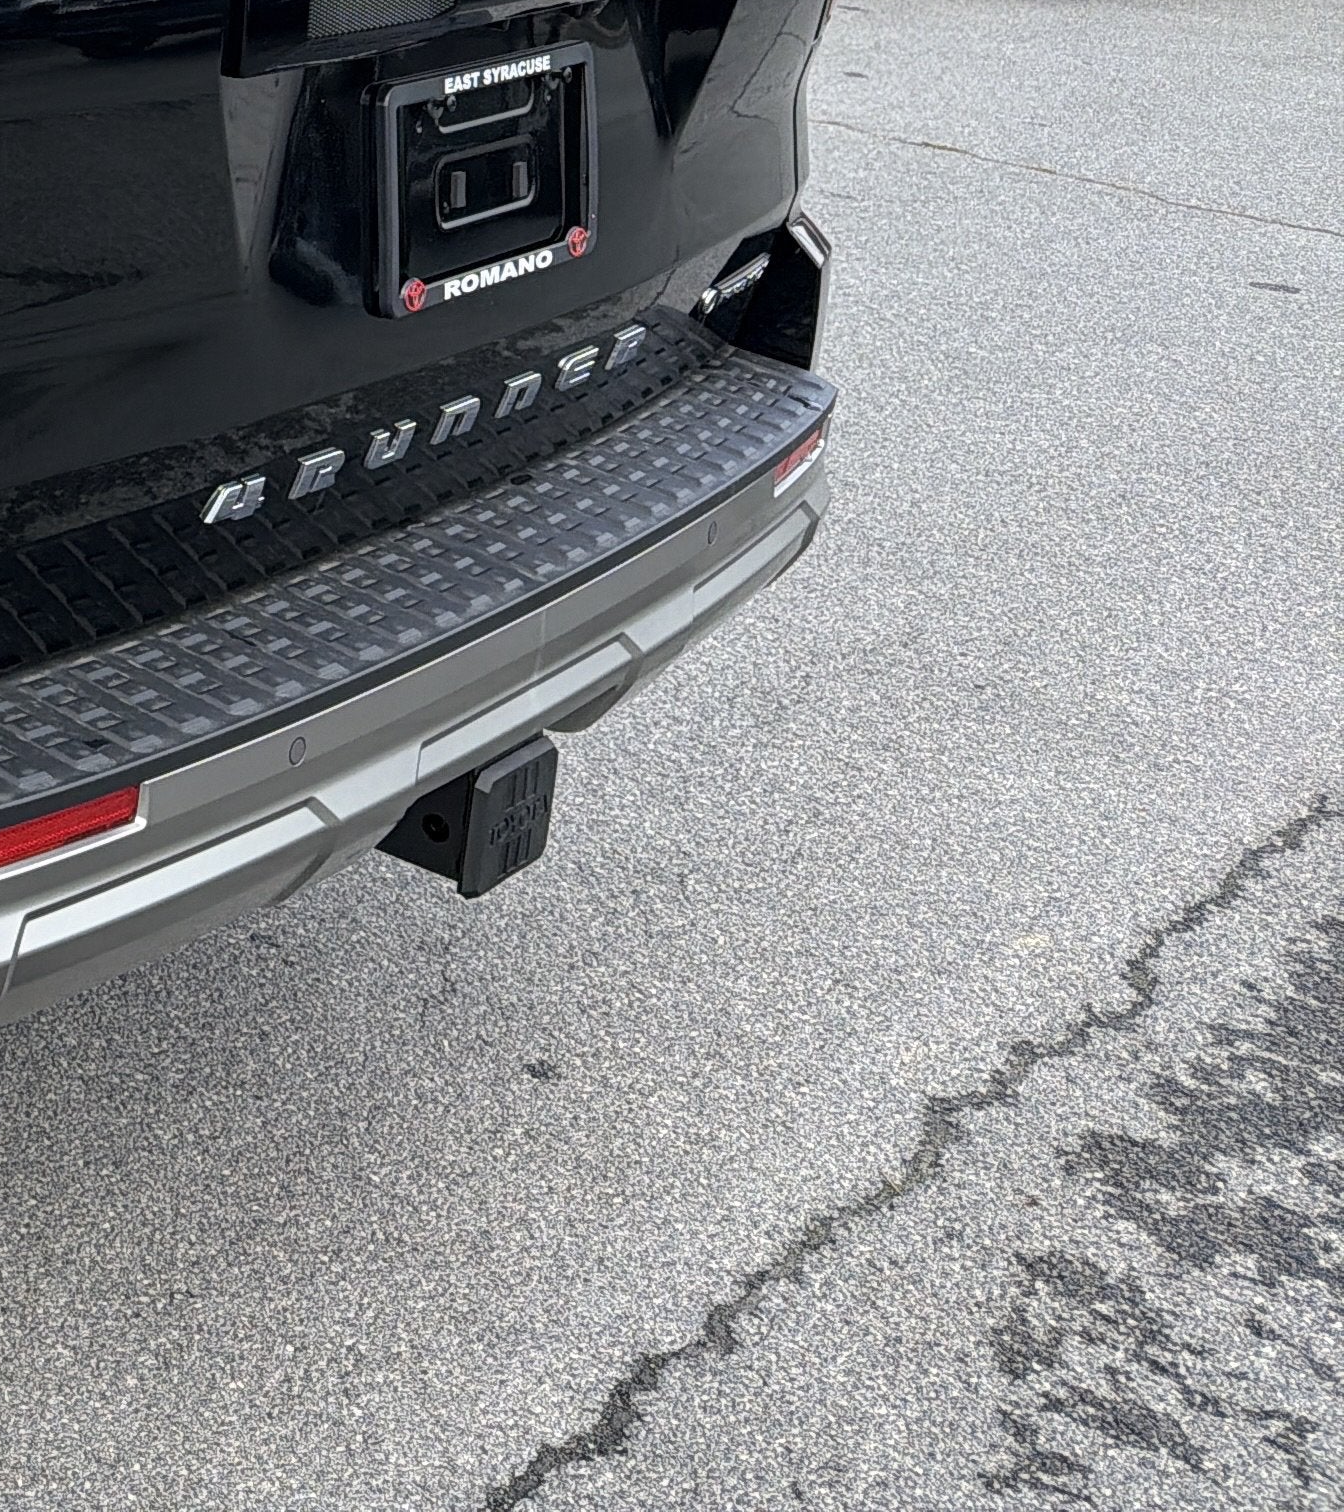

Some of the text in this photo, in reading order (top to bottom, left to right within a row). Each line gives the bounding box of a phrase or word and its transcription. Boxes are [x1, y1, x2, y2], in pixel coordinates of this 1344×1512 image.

[444, 55, 551, 95] EAST SYRACUSE
[443, 249, 553, 300] ROMANO
